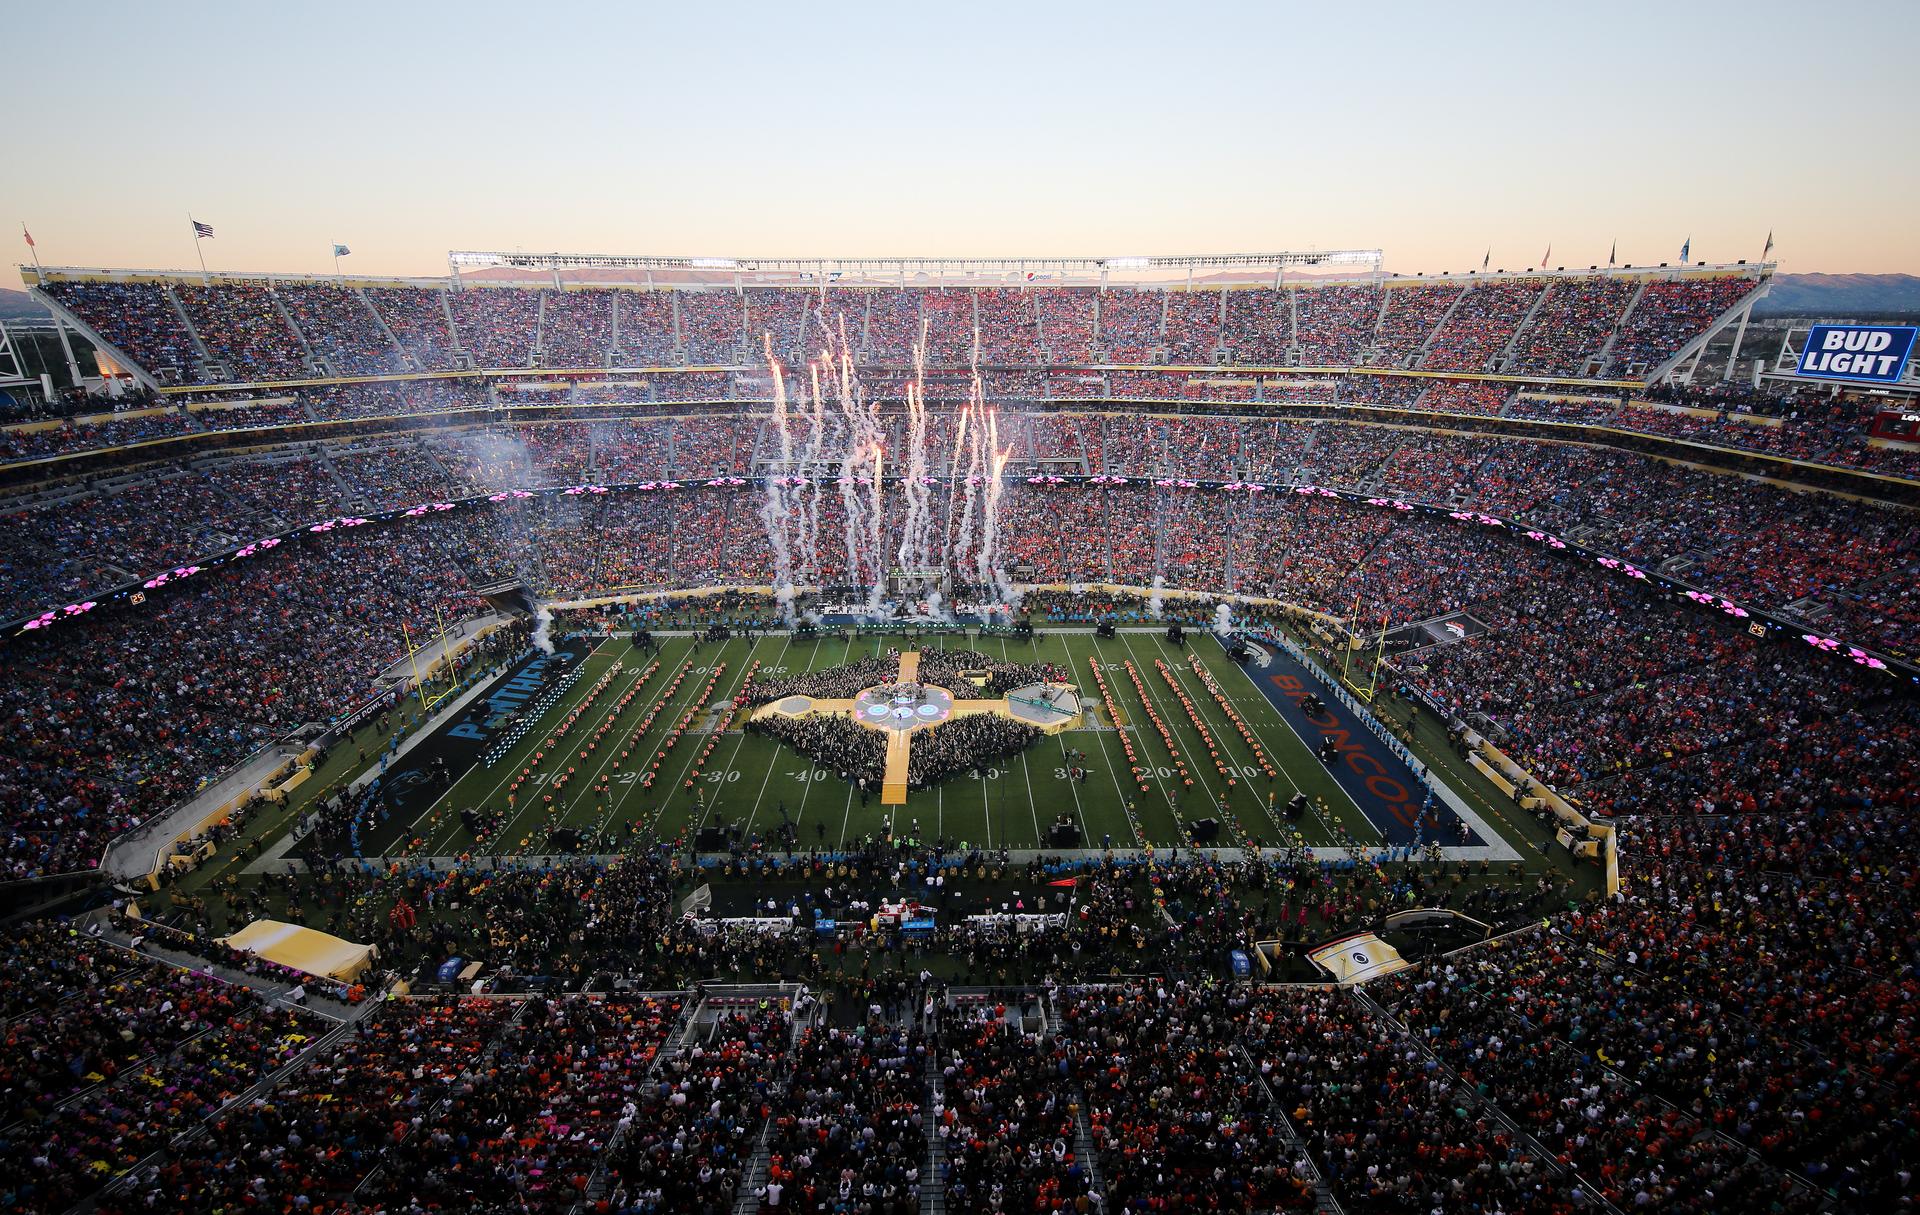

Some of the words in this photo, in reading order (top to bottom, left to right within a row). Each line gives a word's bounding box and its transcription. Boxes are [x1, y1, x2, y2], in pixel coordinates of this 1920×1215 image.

[222, 278, 270, 288] SUPER
[1500, 277, 1541, 285] SUPER
[1821, 330, 1893, 352] BUD
[1802, 352, 1899, 376] LIGHT
[446, 652, 576, 741] PNTHERS
[1403, 680, 1422, 698] SUPER
[1422, 694, 1440, 713] BOWL
[335, 713, 361, 736] SUPER
[362, 702, 383, 718] BOWL
[707, 770, 741, 783] 30
[794, 770, 827, 782] 40
[968, 767, 999, 780] 40
[1226, 766, 1257, 778] 10
